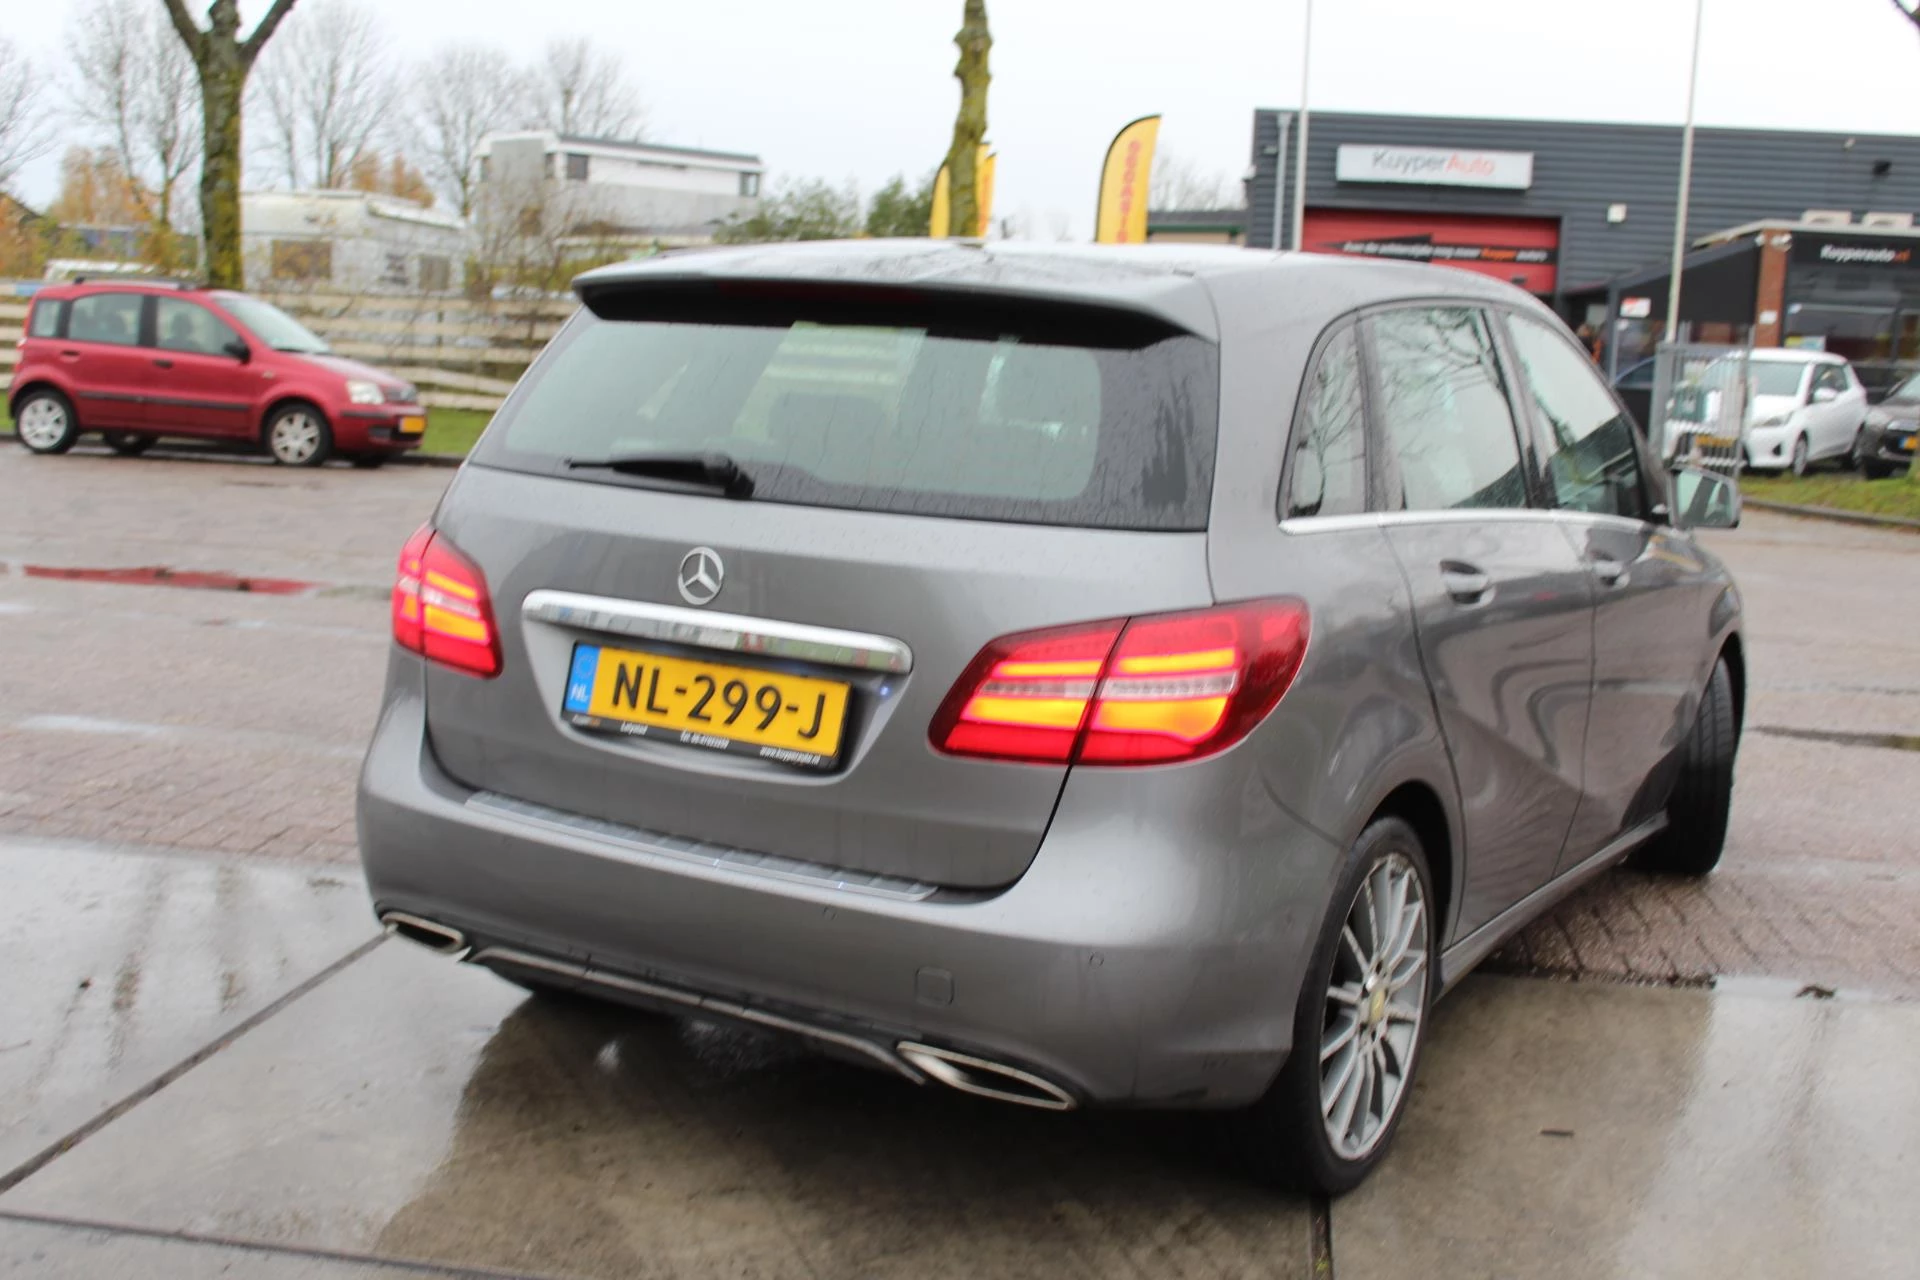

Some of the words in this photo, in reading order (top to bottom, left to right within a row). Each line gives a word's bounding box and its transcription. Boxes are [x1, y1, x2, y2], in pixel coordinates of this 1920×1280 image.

[1372, 149, 1496, 177] KuyperAuto
[570, 683, 589, 702] NL
[611, 661, 827, 740] NL-299-J
